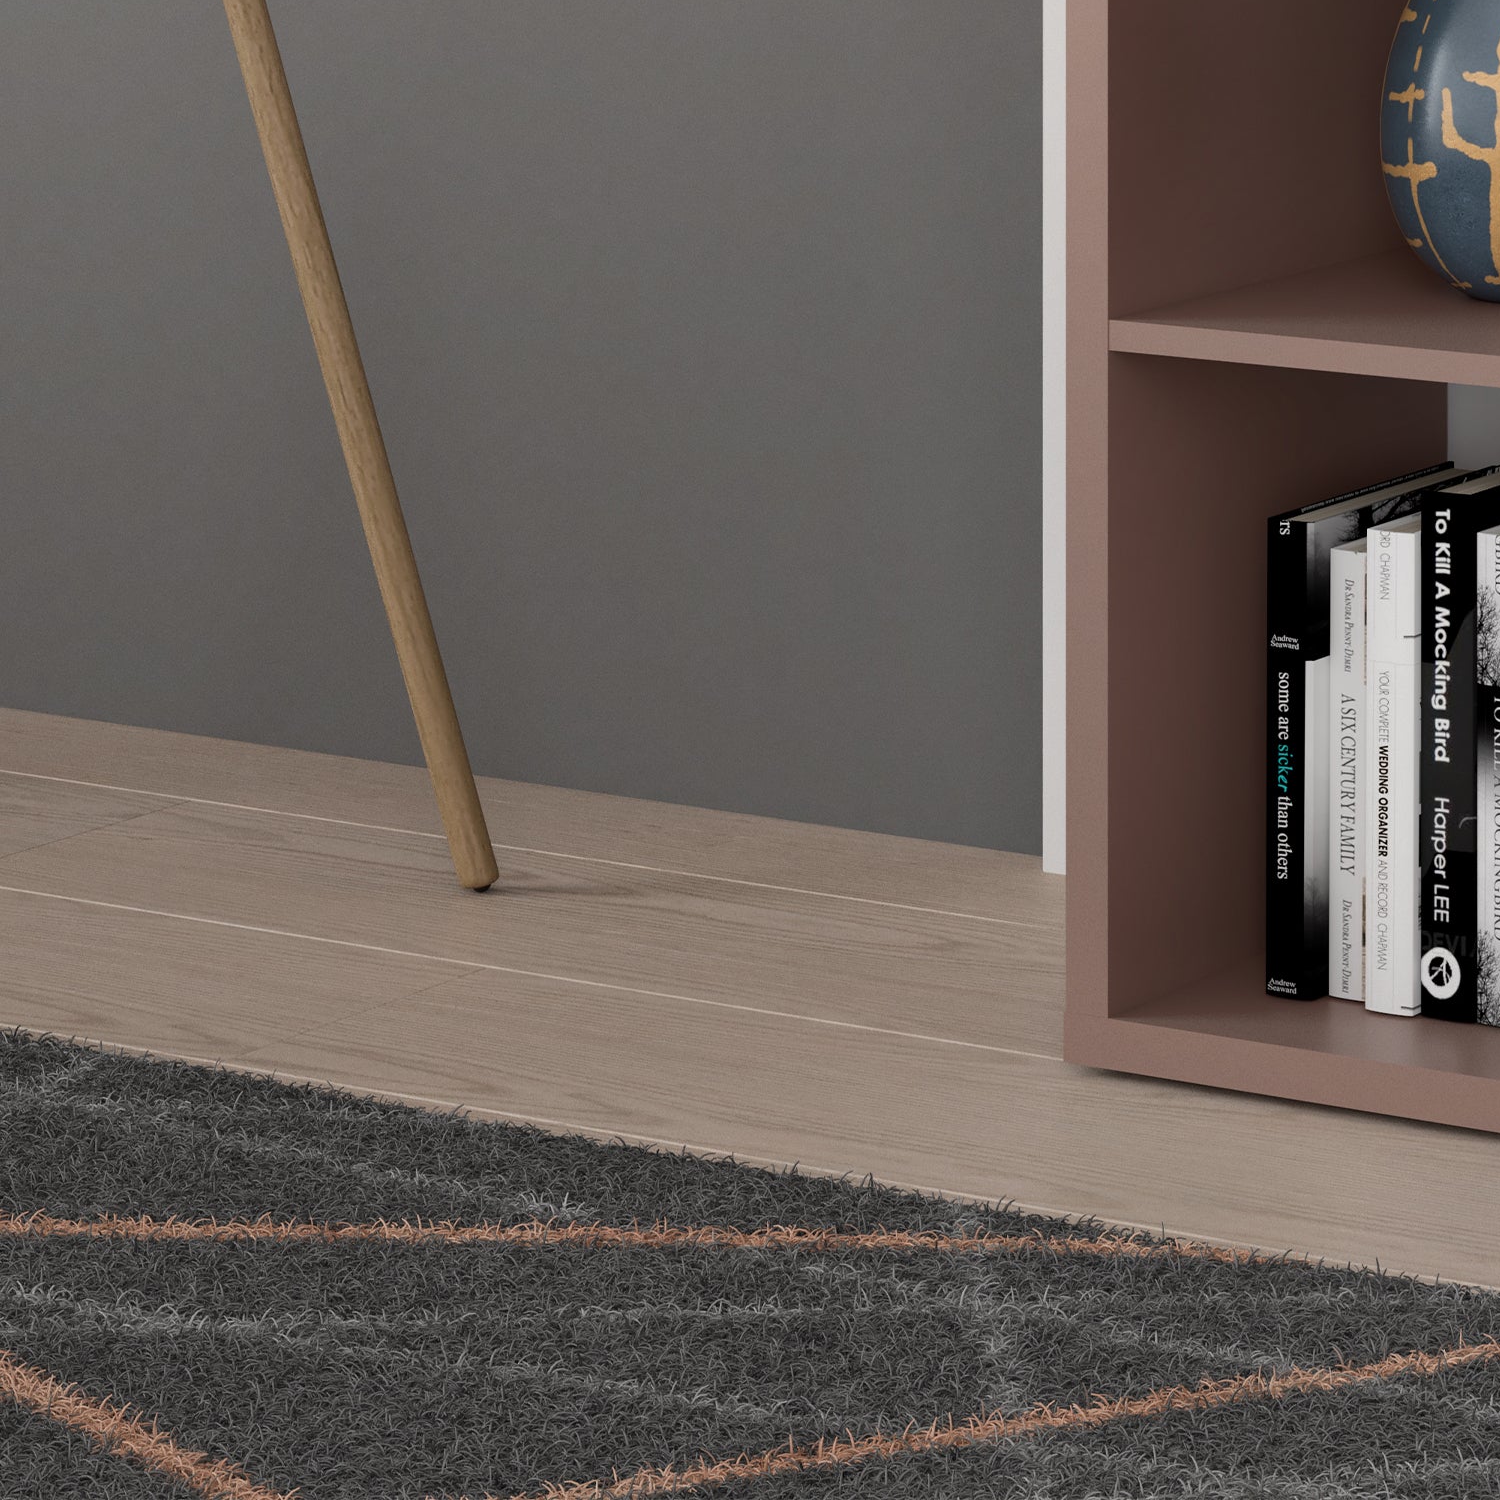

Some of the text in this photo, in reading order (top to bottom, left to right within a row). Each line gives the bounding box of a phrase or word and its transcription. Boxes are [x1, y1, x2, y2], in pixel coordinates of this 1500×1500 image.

[1380, 553, 1390, 600] CHAPMAN
[1270, 639, 1300, 651] Seaward
[1271, 633, 1299, 644] Andrew
[1431, 508, 1450, 763] To Kill A Mocking Bird
[1276, 672, 1293, 880] some are sicker than others
[1340, 693, 1356, 876] A SIX CENTURY FAMILY
[1377, 671, 1389, 971] YOUR COMPLETE WEDDING ORGANIZER AND RECORD CHAPMAN
[1431, 797, 1450, 923] Harper LEE
[1267, 983, 1297, 995] Seaward
[1269, 977, 1297, 988] Andrew
